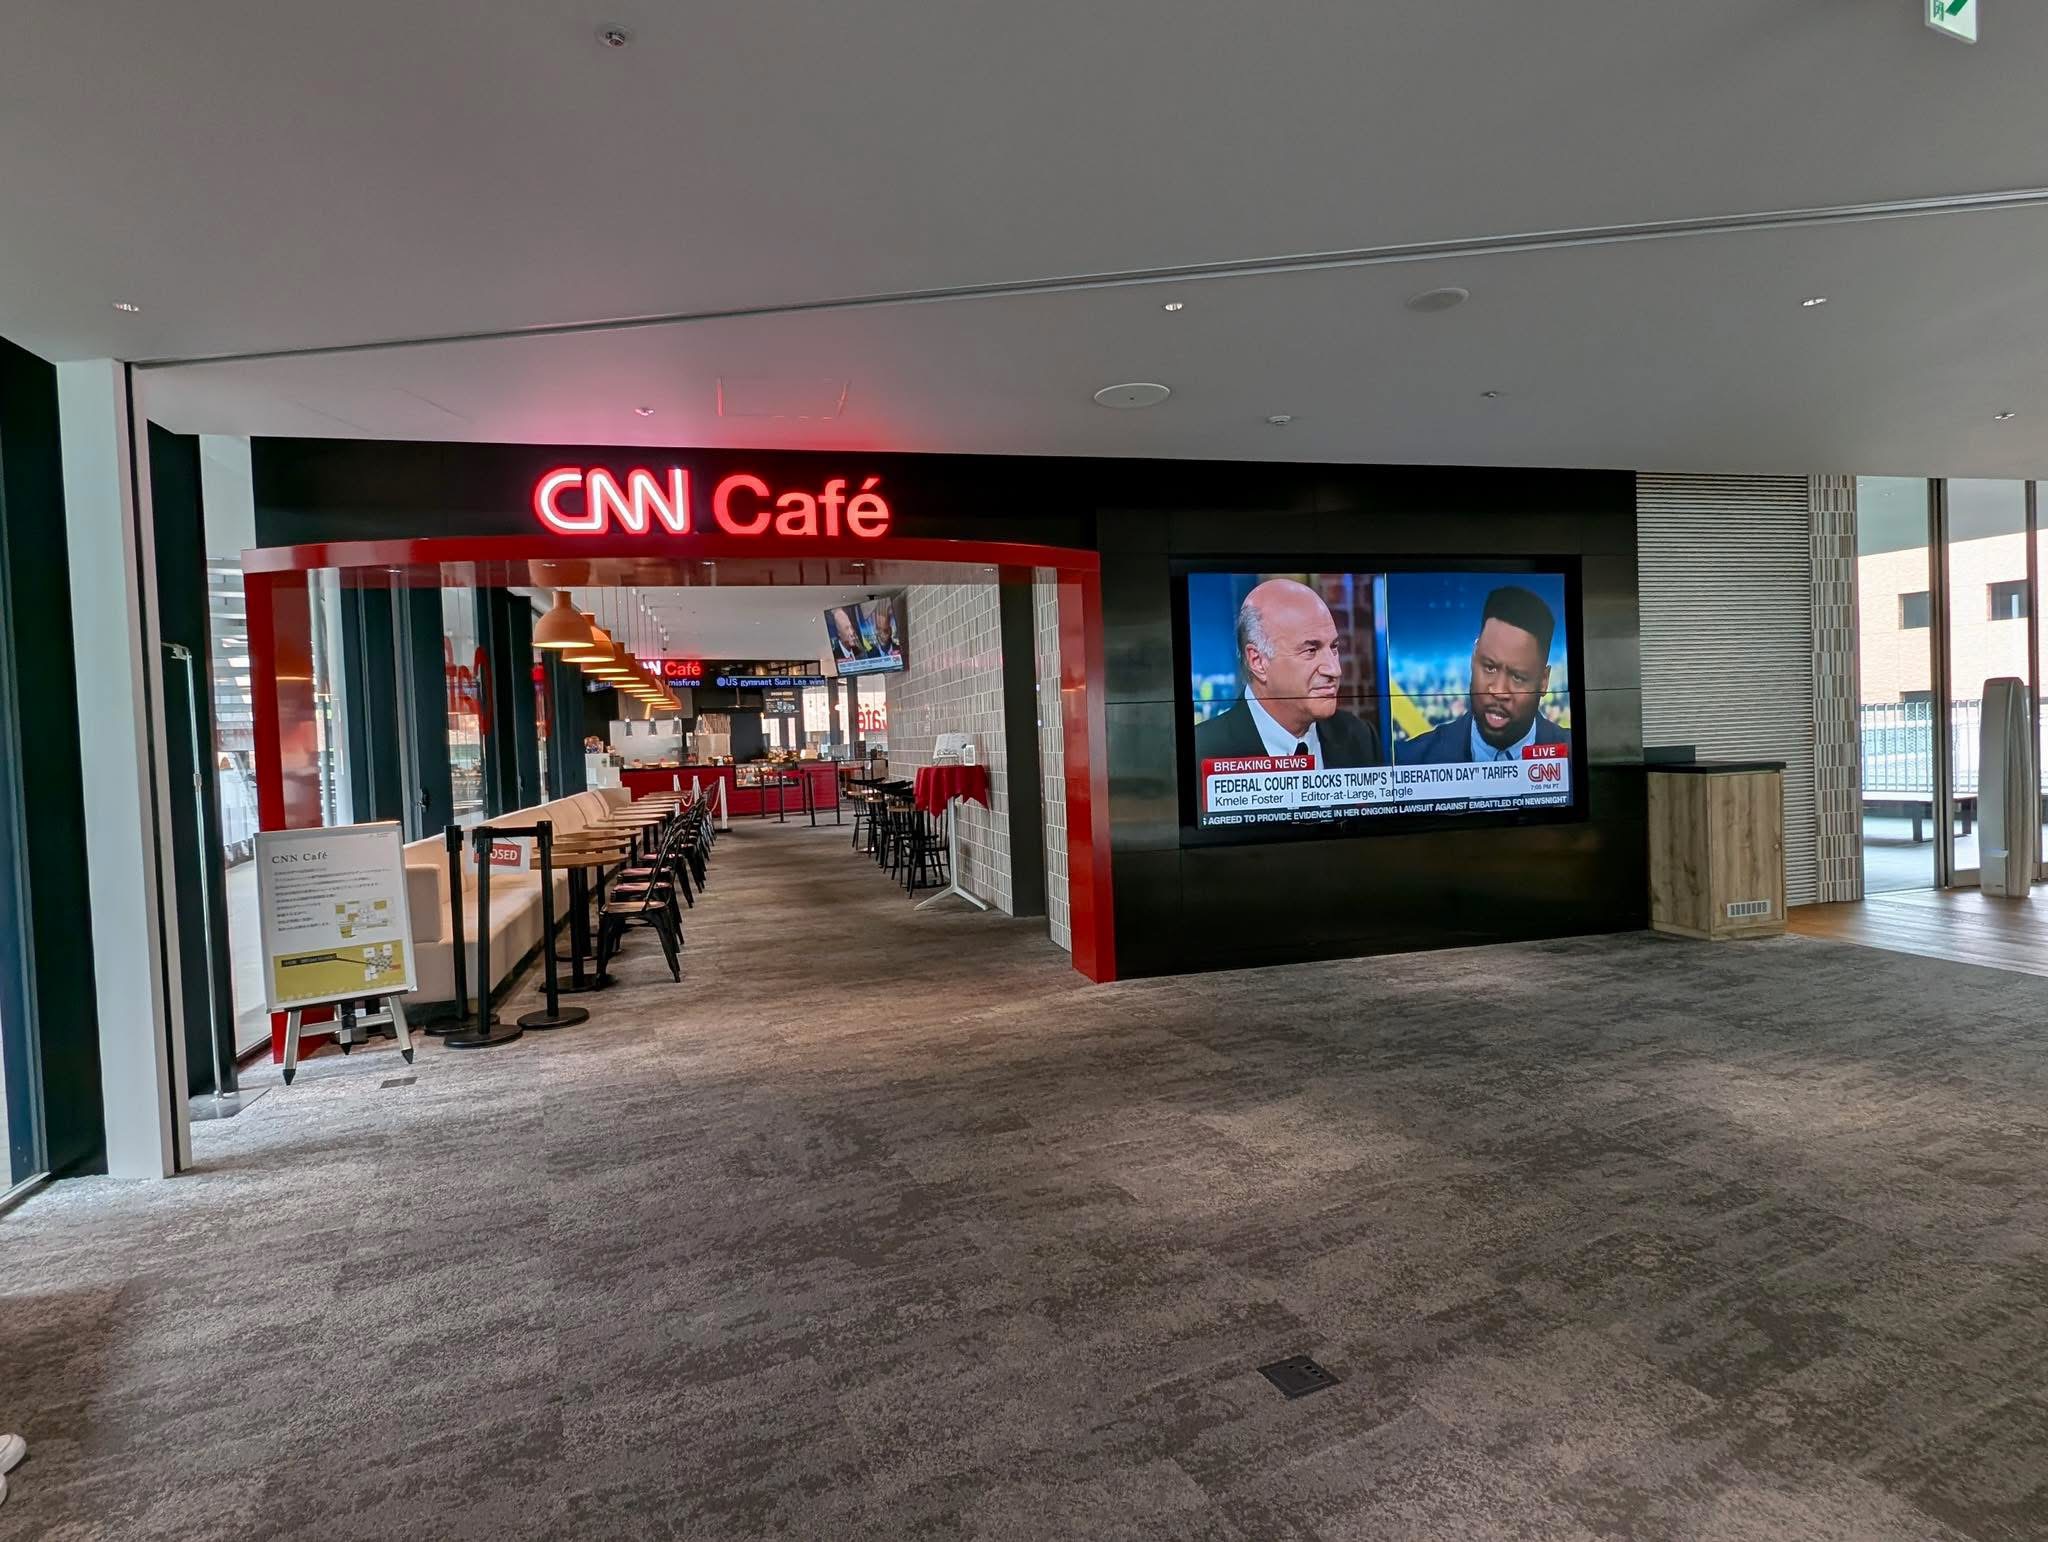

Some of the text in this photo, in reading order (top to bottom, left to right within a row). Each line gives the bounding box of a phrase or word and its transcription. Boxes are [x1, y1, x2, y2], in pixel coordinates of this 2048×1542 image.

[534, 468, 890, 538] CNN Café
[664, 661, 701, 676] Café
[1532, 747, 1556, 757] LIVE
[1214, 758, 1307, 772] BREAKING NEWS
[1528, 763, 1560, 782] CNN
[1214, 778, 1261, 793] FEDERAL
[1264, 776, 1299, 791] COURT
[1302, 773, 1342, 789] BLOCKS
[1344, 771, 1387, 787] TRUMP'S
[1455, 767, 1480, 781] DAY"
[1482, 765, 1519, 780] TARIFFS
[1215, 786, 1413, 806] Kmele Foster Editor-at-Large, Tangle
[1525, 795, 1567, 806] NEWSNIGHT
[1208, 816, 1242, 825] AGREED
[1244, 815, 1255, 823] TO
[1257, 812, 1292, 822] PROVIDE
[1294, 809, 1332, 820] EVIDENCE
[1334, 809, 1342, 818] IN
[1344, 808, 1359, 817] HER
[1361, 805, 1398, 815] ONGOING
[1400, 804, 1433, 813] LAWSUIT
[1435, 801, 1468, 811] AGAINST
[1469, 799, 1511, 809] EMBATTLED
[271, 850, 328, 864] CNN Café
